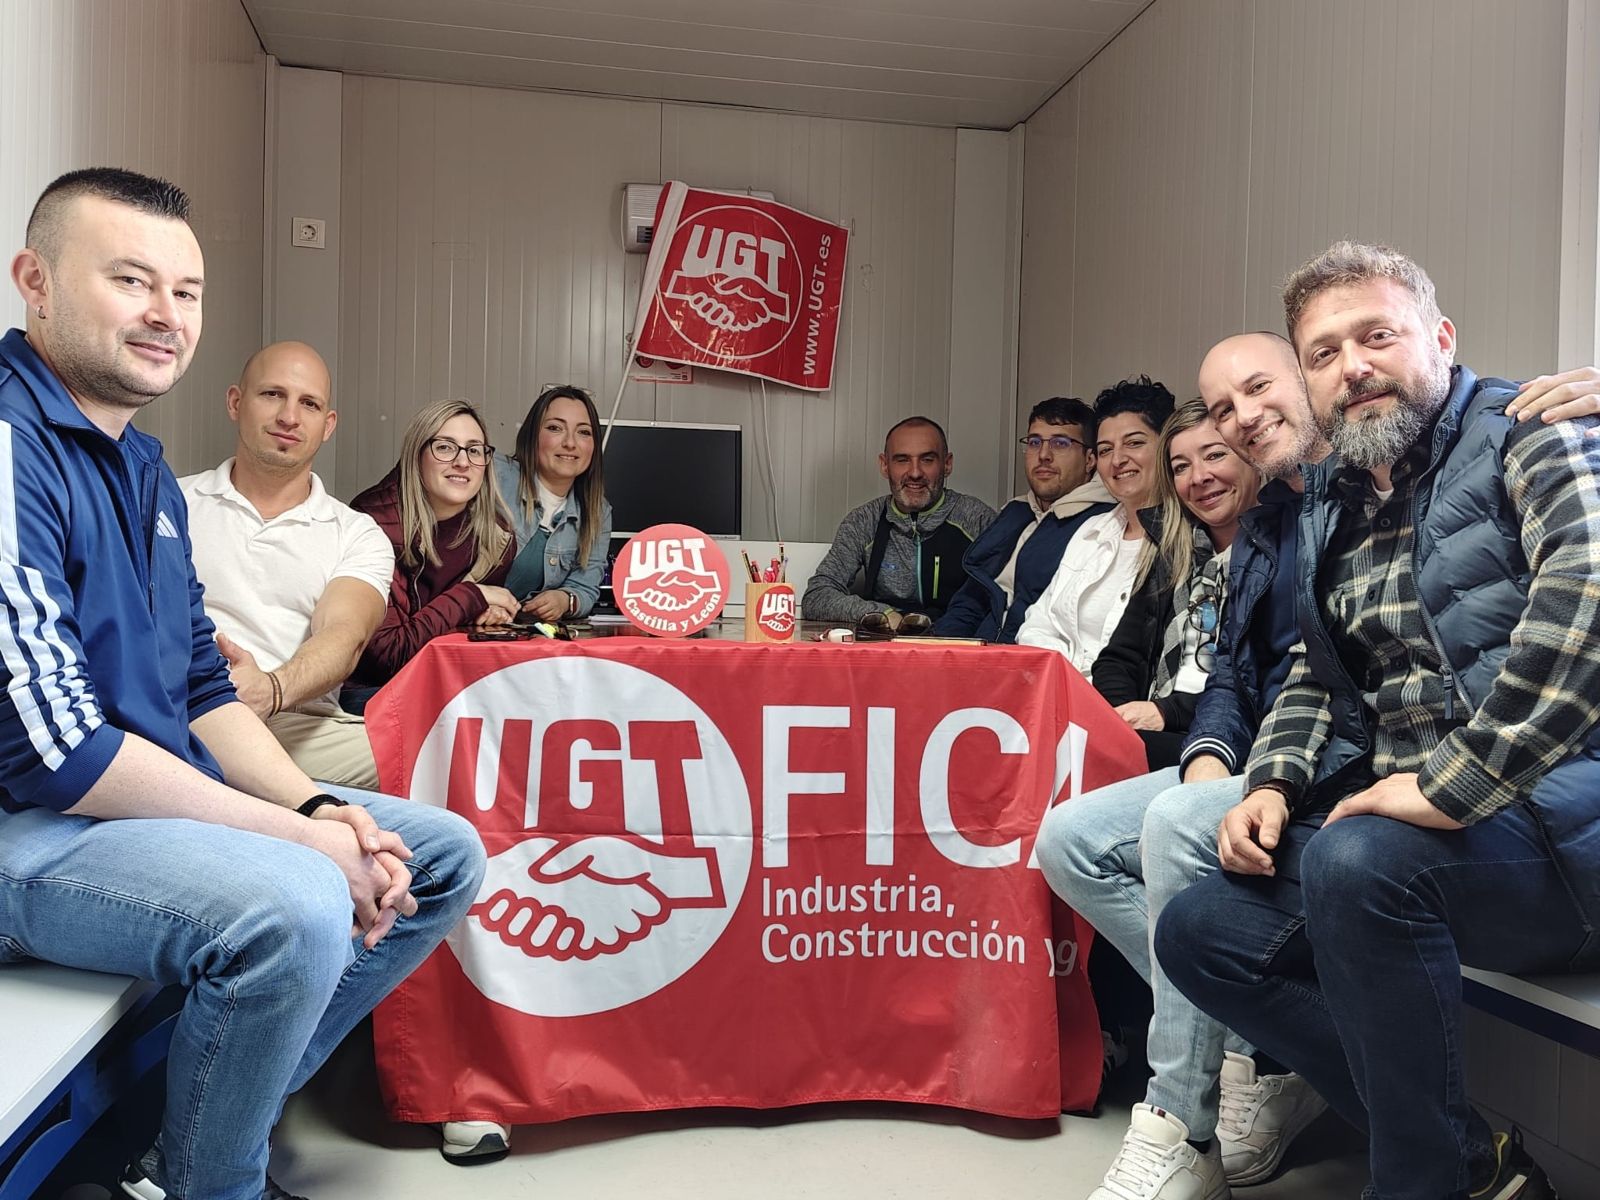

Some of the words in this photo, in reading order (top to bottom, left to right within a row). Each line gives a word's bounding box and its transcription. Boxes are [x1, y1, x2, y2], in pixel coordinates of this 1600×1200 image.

[682, 225, 785, 292] UGT
[803, 234, 831, 375] www.UGT.es
[631, 538, 705, 580] UGT
[625, 598, 677, 631] Castilla
[681, 620, 689, 632] y
[692, 593, 721, 626] León
[447, 717, 703, 850] UGT
[762, 874, 955, 918] Industria,
[761, 920, 1025, 964] Construcción
